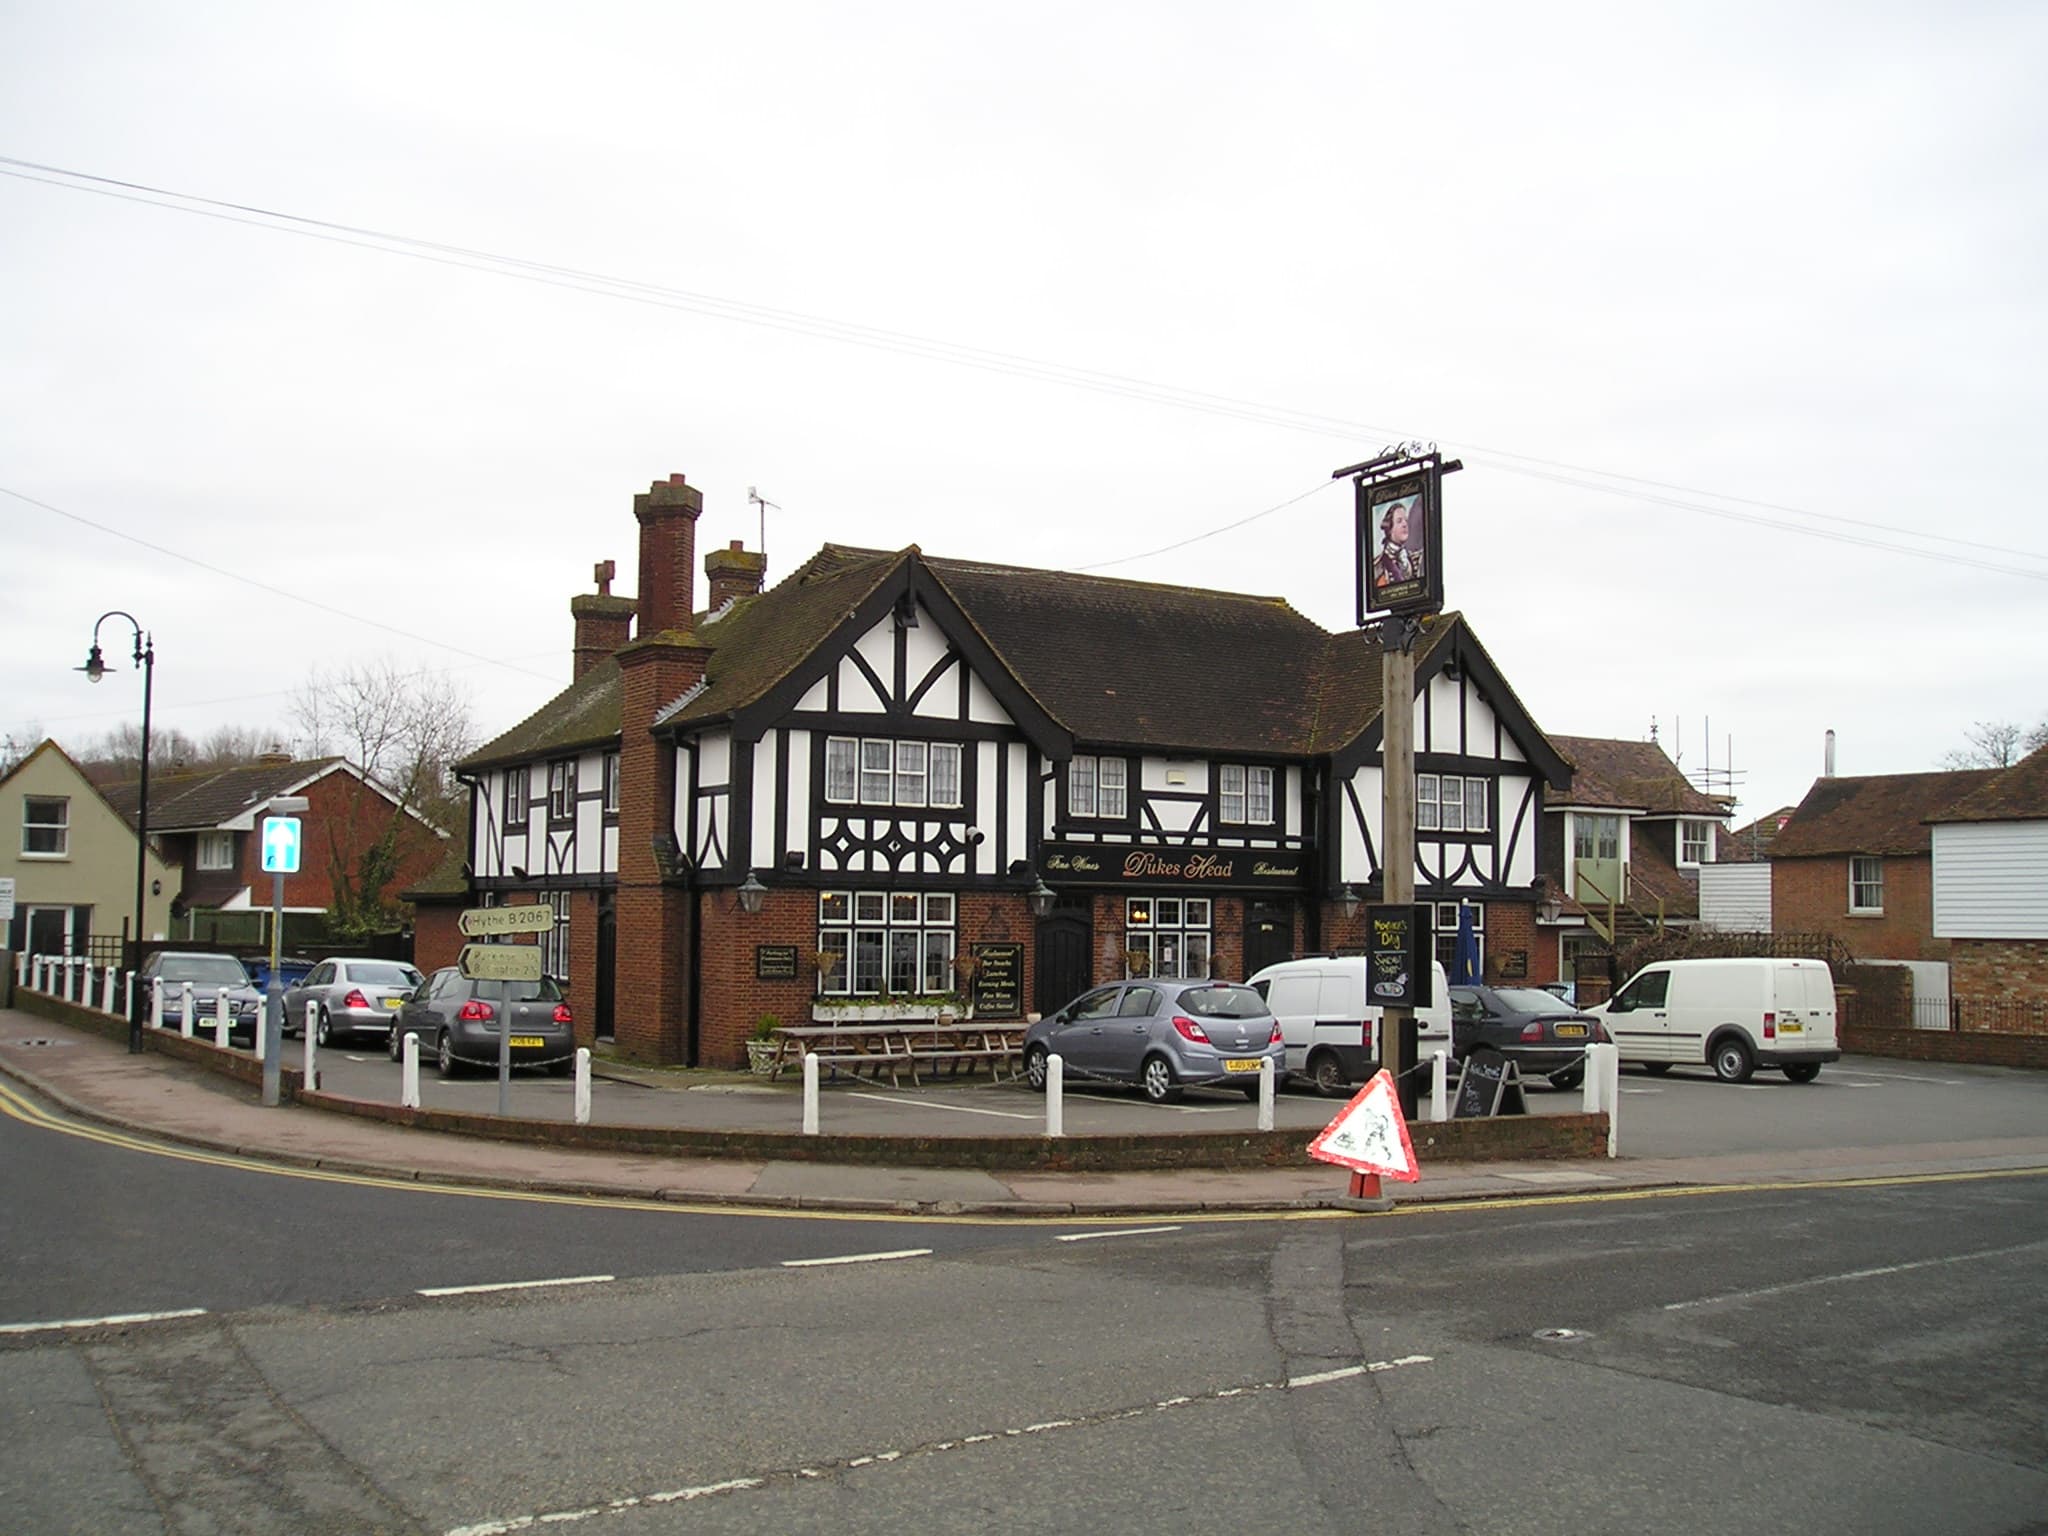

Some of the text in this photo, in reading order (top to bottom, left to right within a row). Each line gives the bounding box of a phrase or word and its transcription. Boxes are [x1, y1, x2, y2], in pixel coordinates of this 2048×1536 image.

[1047, 854, 1101, 871] Fine Wines
[1122, 851, 1233, 879] Dukes Head
[472, 914, 505, 927] Hythe
